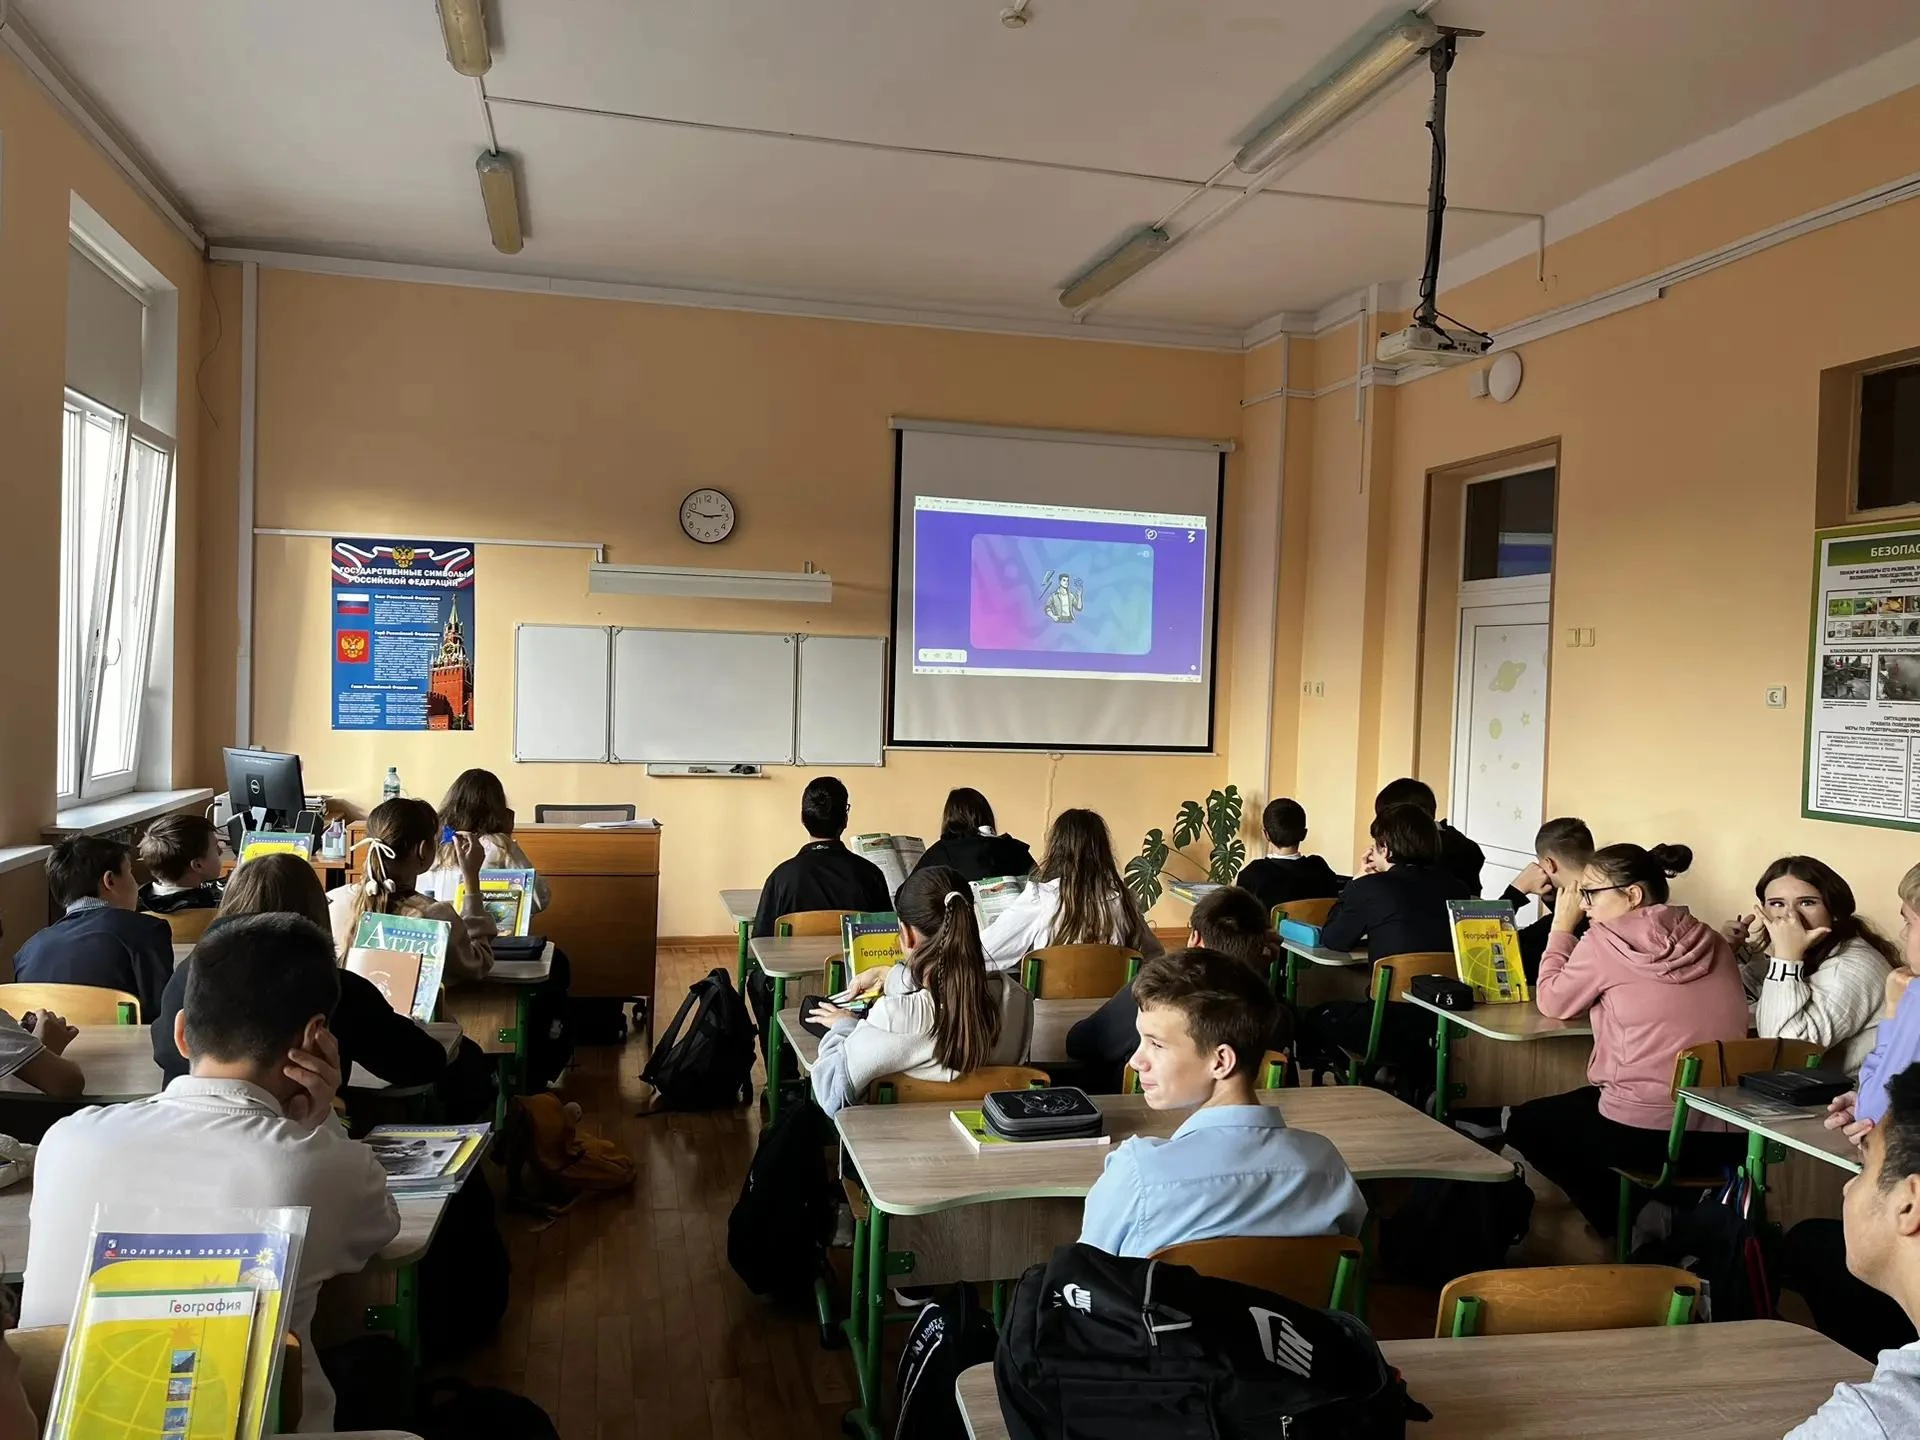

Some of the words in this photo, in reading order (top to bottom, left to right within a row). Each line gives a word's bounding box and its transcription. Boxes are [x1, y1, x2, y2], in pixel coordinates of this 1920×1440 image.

[704, 495, 712, 503] 12
[720, 504, 726, 512] 2
[688, 521, 695, 529] 8
[340, 566, 422, 576] ГОСУДАРСТВЕННЫЕ
[424, 569, 468, 578] СИМВОЛЫ
[349, 576, 406, 585] РОССИЙСКОЙ
[408, 578, 458, 587] ФЕДЕРАЦИИ
[361, 921, 441, 956] Атлас
[1506, 935, 1512, 945] 7
[120, 1248, 191, 1256] ПОЛЯРНАЯ
[169, 1298, 241, 1316] География
